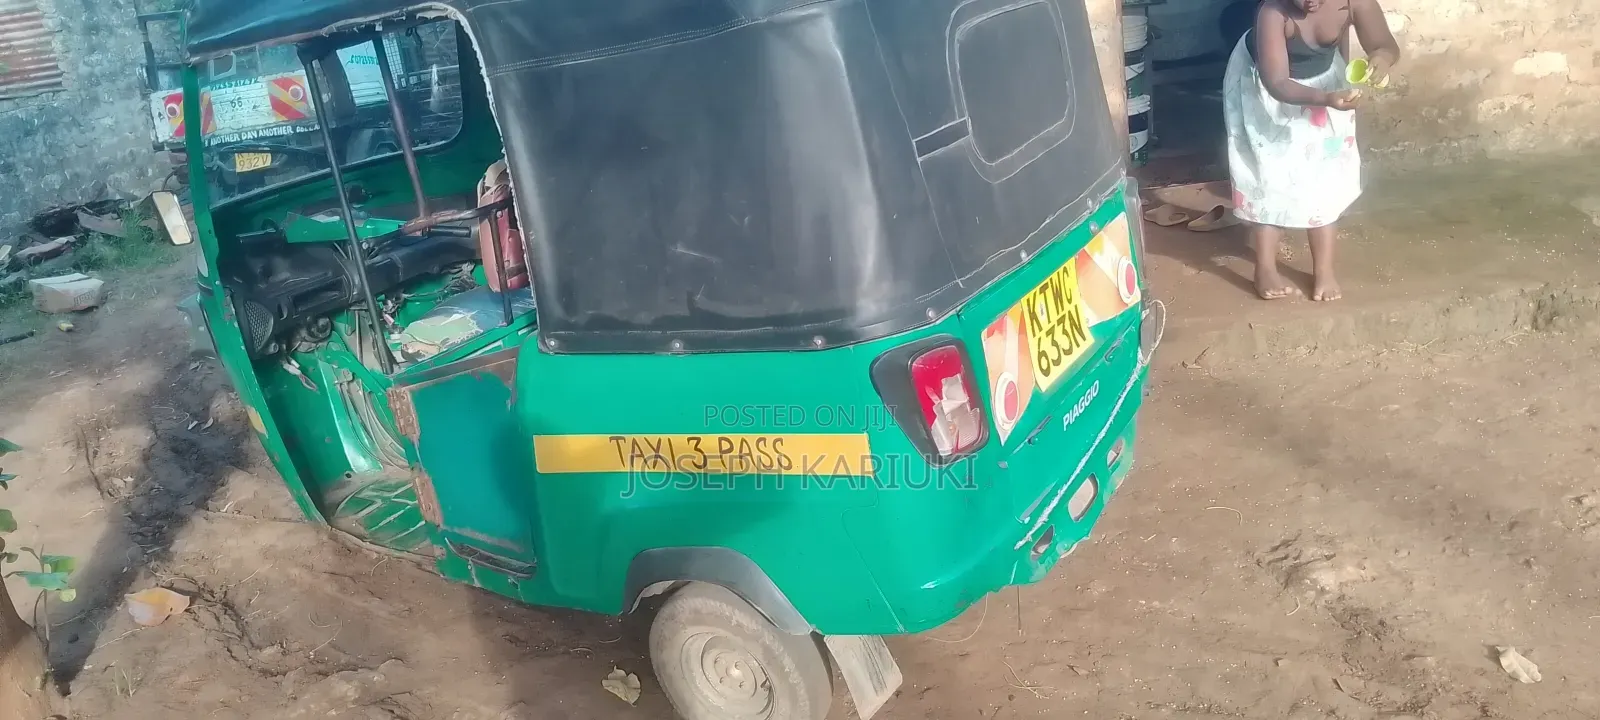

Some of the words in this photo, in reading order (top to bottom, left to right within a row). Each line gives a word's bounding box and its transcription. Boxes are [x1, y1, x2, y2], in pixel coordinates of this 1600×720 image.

[210, 129, 241, 146] ANOTHER
[258, 125, 294, 138] ANOTHER
[296, 123, 321, 134] DOLLA
[238, 154, 268, 171] 932V
[1026, 265, 1074, 338] KTWC
[1036, 304, 1087, 378] 633N
[1062, 379, 1101, 432] PIAGGIO
[608, 435, 678, 471] TAXI
[686, 436, 708, 470] 3
[717, 436, 793, 471] PASS
